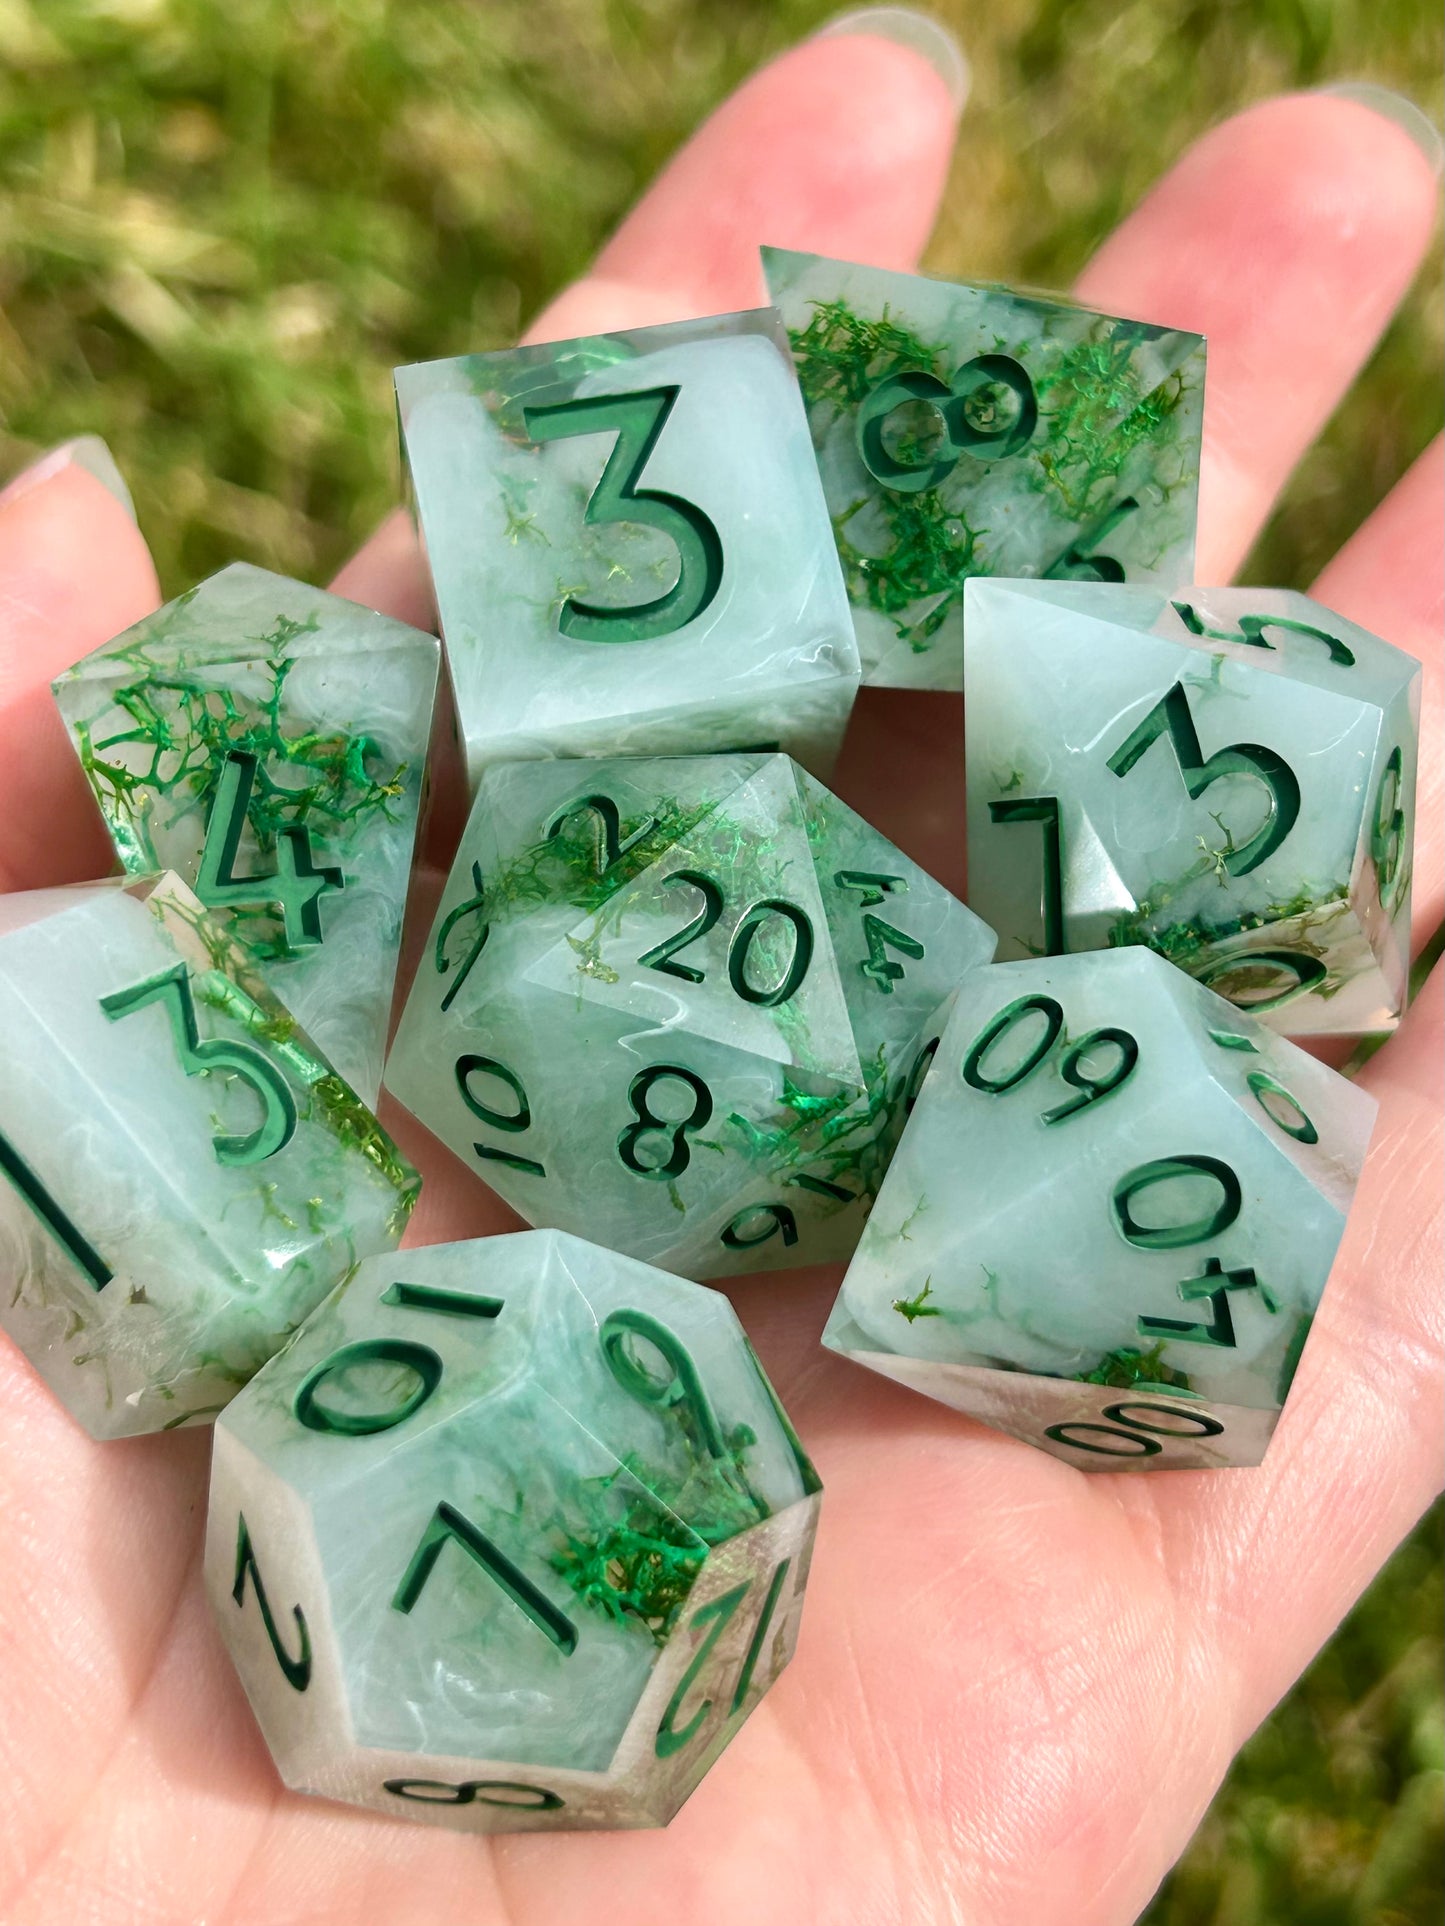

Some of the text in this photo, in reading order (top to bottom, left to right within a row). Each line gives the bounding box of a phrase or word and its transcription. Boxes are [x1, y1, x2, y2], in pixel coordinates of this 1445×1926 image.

[857, 354, 1038, 492] 8
[523, 385, 724, 643] 3
[194, 748, 346, 949] 4
[542, 795, 661, 875] 2
[1106, 680, 1301, 877] 3
[1371, 745, 1406, 910] 8
[637, 869, 815, 1007] 20
[98, 961, 298, 1168] 3
[454, 1053, 547, 1178] 10
[616, 1062, 714, 1181] 8
[1112, 1154, 1258, 1348] 40
[293, 1281, 505, 1437] 10
[1044, 1401, 1225, 1457] 00
[232, 1510, 312, 1692] 2
[391, 1500, 579, 1657] 7
[654, 1556, 792, 1759] 12
[382, 1778, 566, 1811] 8
